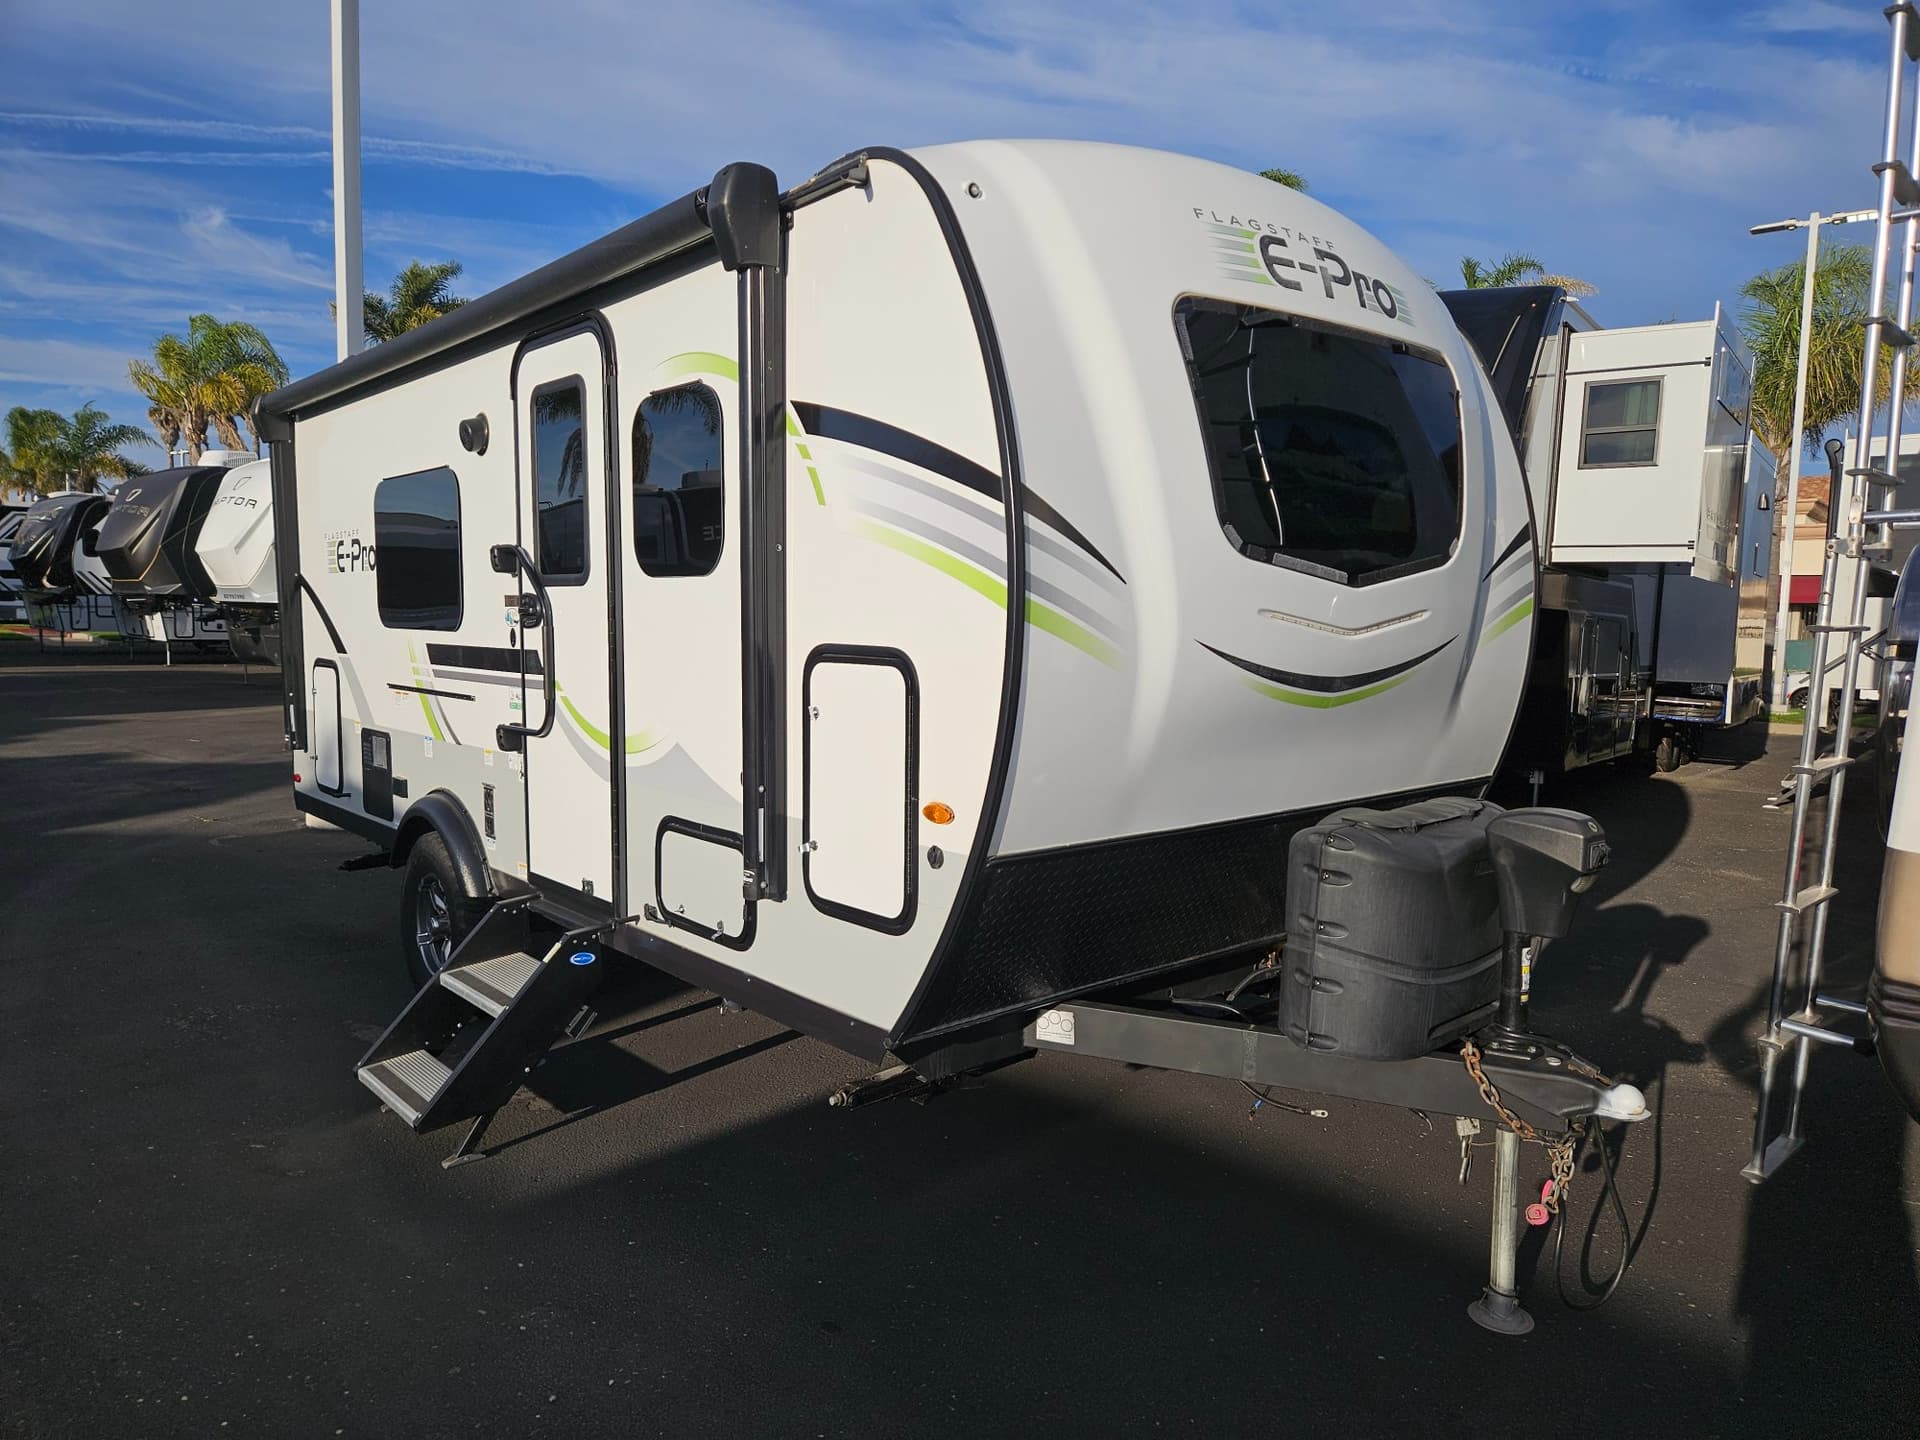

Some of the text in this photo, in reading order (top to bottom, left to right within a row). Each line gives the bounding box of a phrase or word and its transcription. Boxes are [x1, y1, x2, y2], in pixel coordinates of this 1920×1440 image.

[1193, 207, 1335, 250] FLAGSTAFF
[1258, 233, 1398, 320] E-Pro
[336, 538, 377, 573] E-Pro
